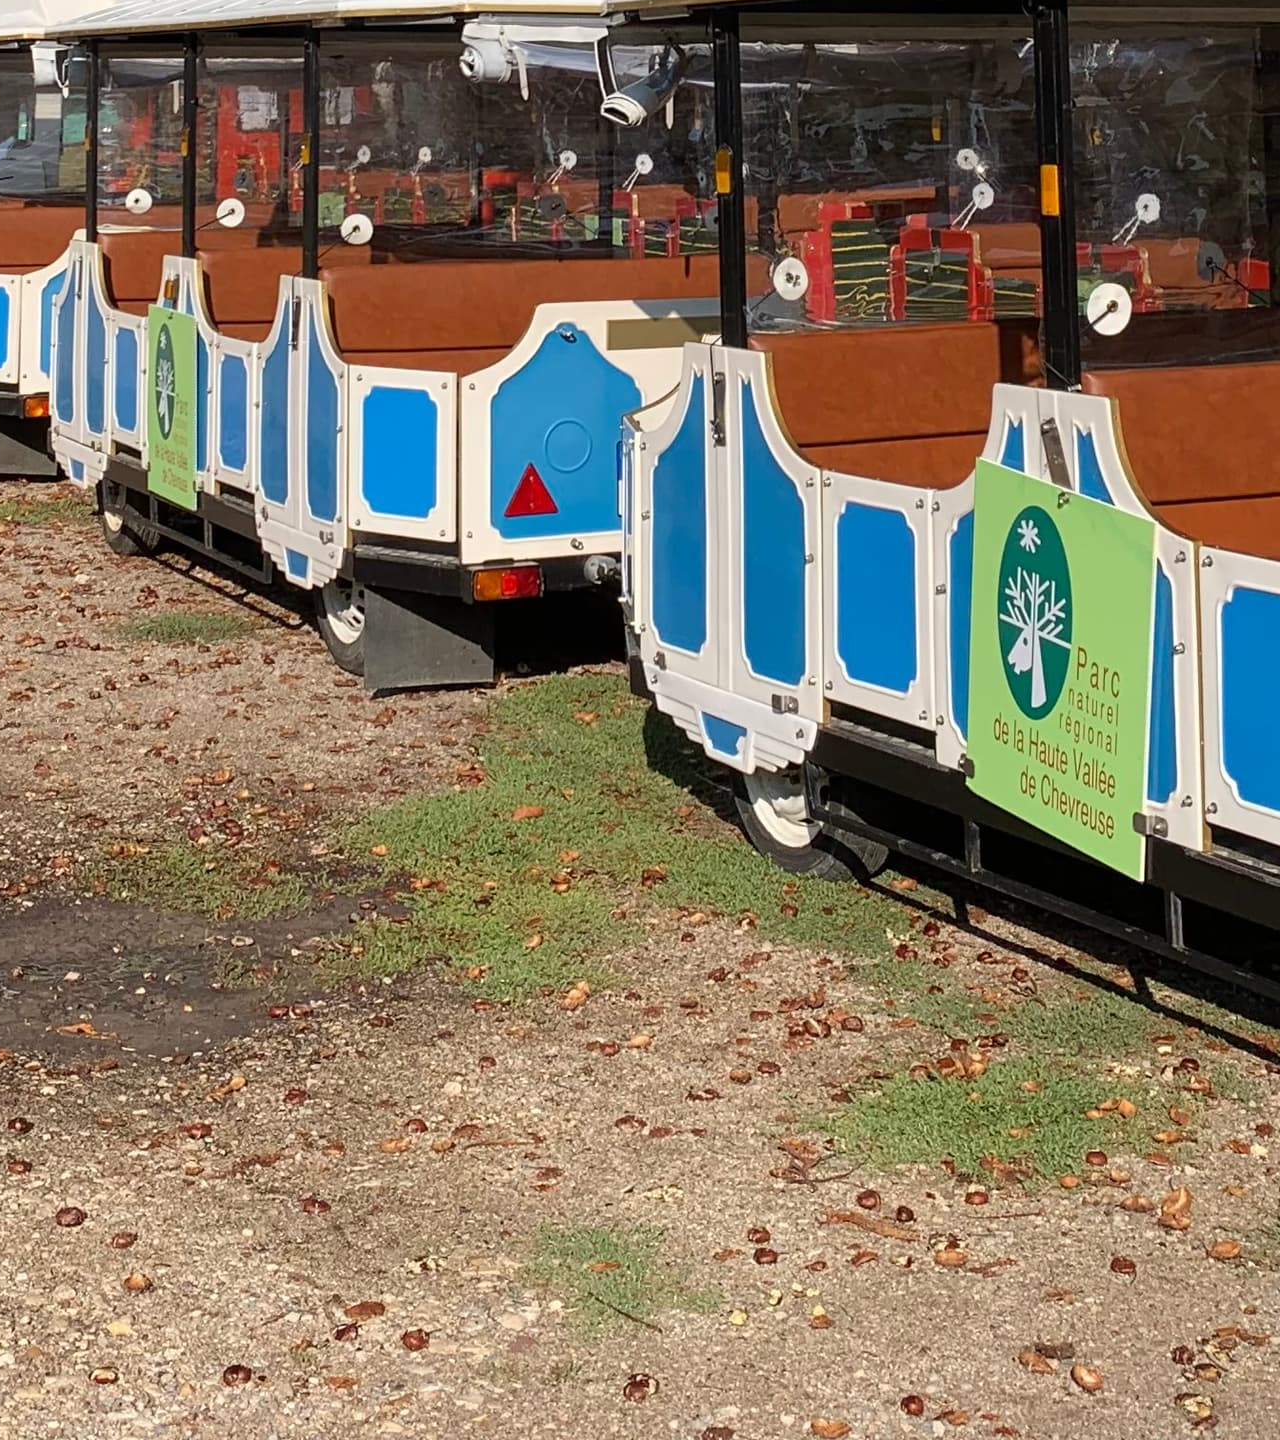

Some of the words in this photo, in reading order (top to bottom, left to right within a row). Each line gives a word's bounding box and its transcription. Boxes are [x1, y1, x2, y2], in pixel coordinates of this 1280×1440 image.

[1076, 646, 1120, 698] Parc
[1068, 687, 1119, 727] naturel
[993, 712, 1009, 745] de
[1013, 720, 1024, 753] la
[1029, 727, 1068, 775] Haute
[1073, 748, 1116, 799] Vallée
[1059, 711, 1118, 756] régional
[1020, 765, 1036, 799] de
[1041, 774, 1114, 839] Chevreuse
